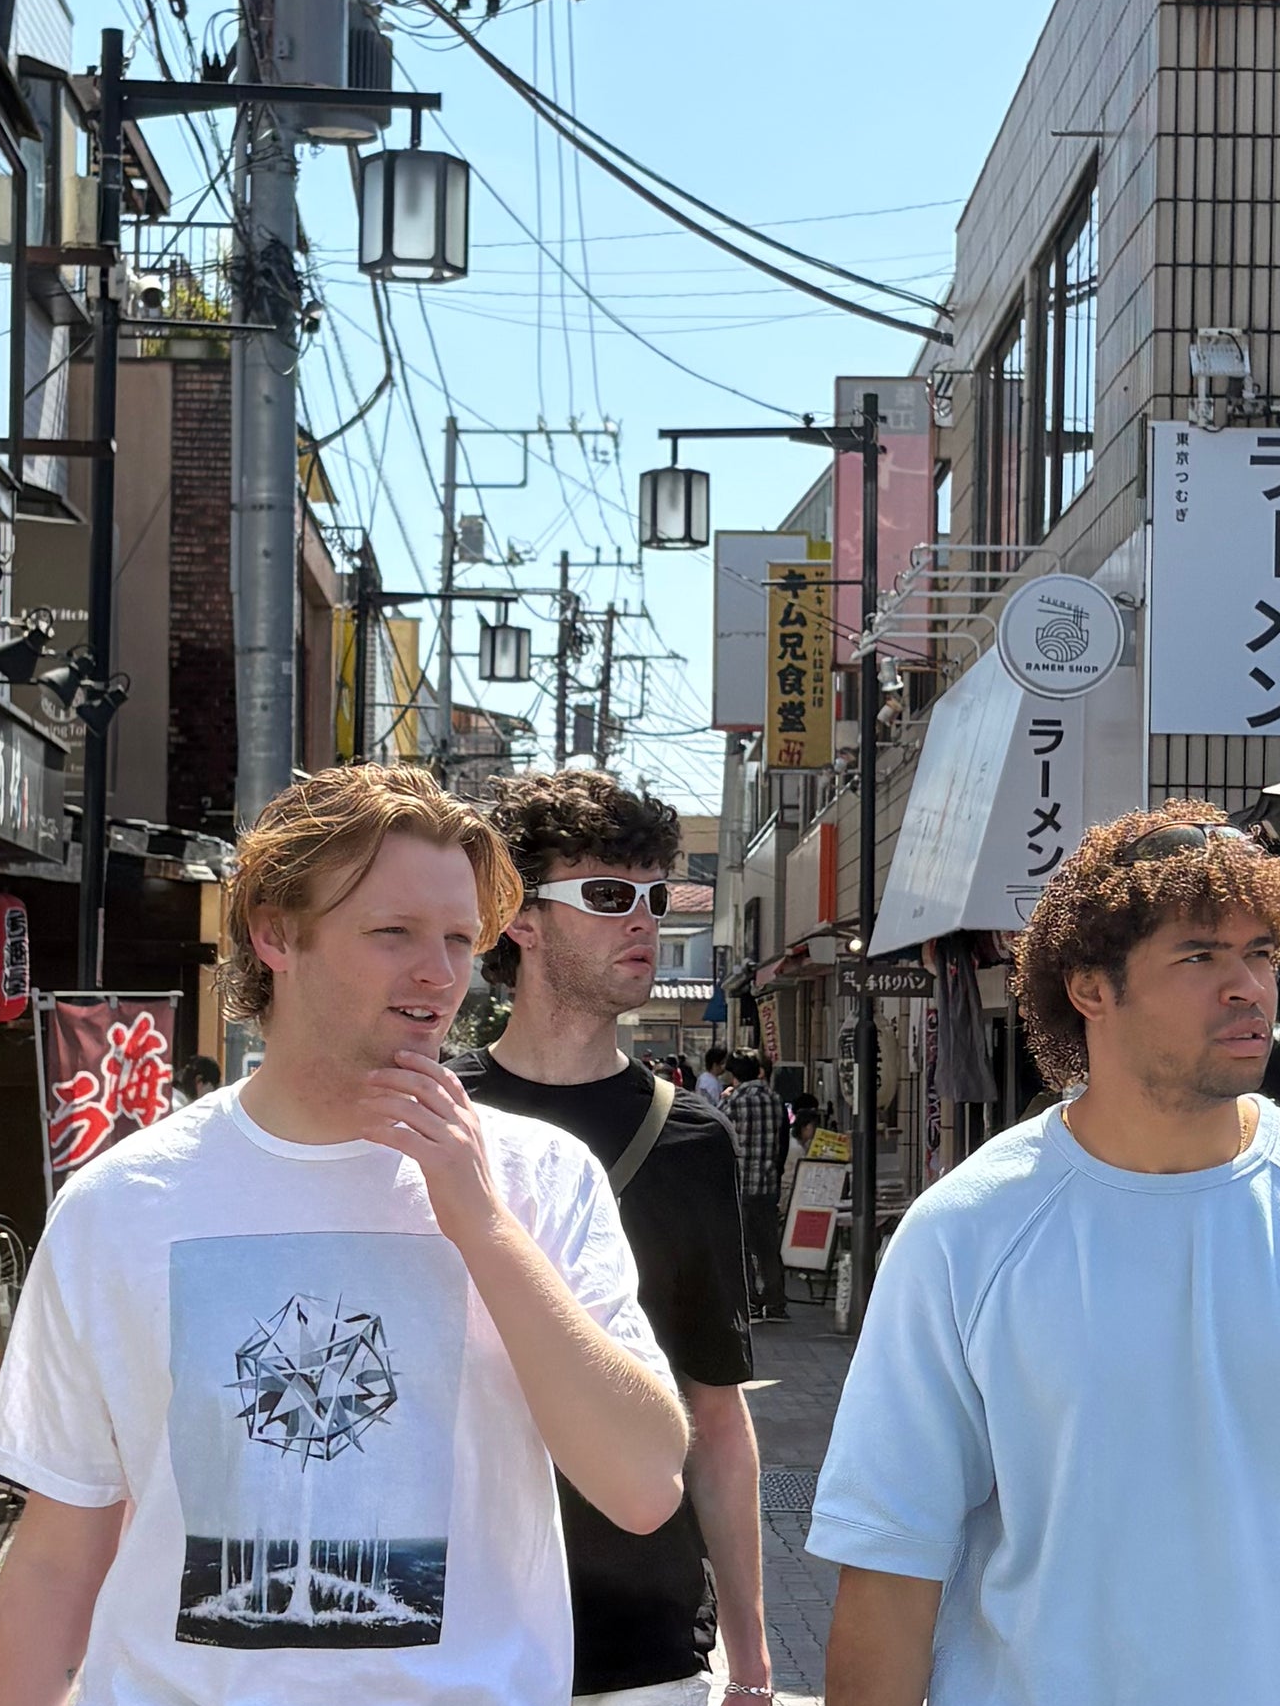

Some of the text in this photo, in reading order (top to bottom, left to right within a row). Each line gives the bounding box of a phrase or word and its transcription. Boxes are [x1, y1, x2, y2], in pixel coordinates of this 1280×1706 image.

[1175, 432, 1189, 523] 東京つむぎ
[777, 570, 808, 733] キム兄食堂
[1025, 662, 1099, 674] RAMEN SHOP
[1026, 718, 1065, 878] ラーメン
[864, 972, 927, 992] 手作りパン
